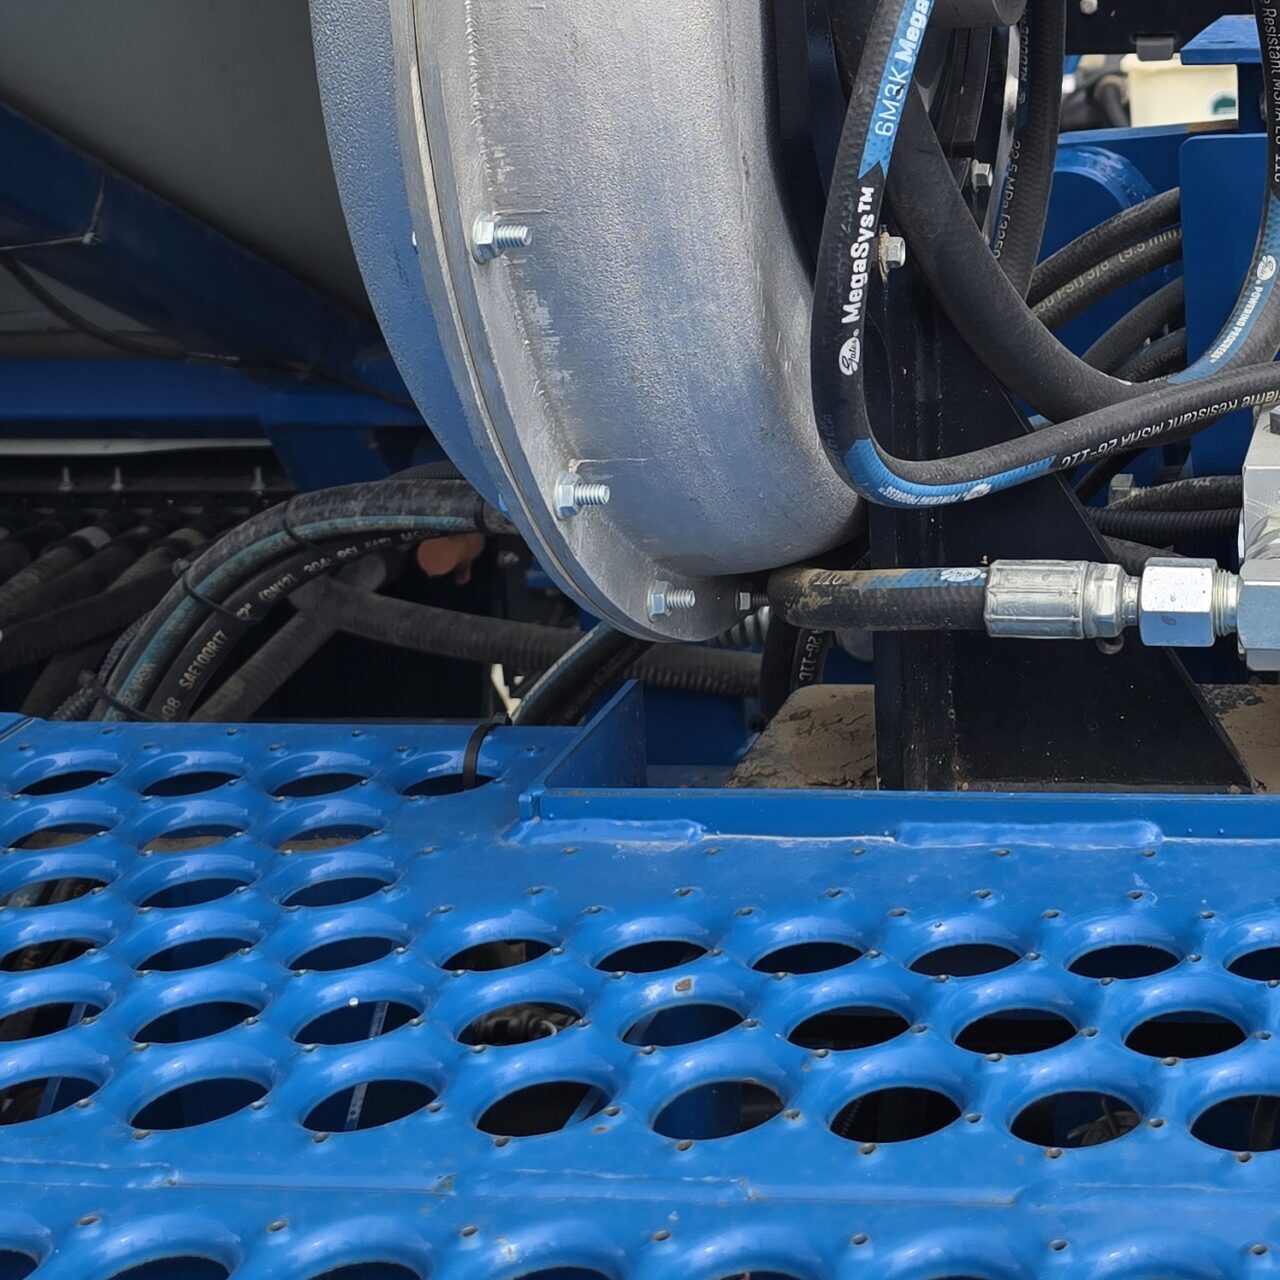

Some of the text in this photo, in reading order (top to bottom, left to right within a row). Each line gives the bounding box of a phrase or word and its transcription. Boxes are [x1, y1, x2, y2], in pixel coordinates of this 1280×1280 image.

[875, 67, 909, 136] 6M3K
[1236, 286, 1264, 327] POWERING
[1166, 399, 1238, 429] Resistant
[179, 630, 228, 691] SAE100R17
